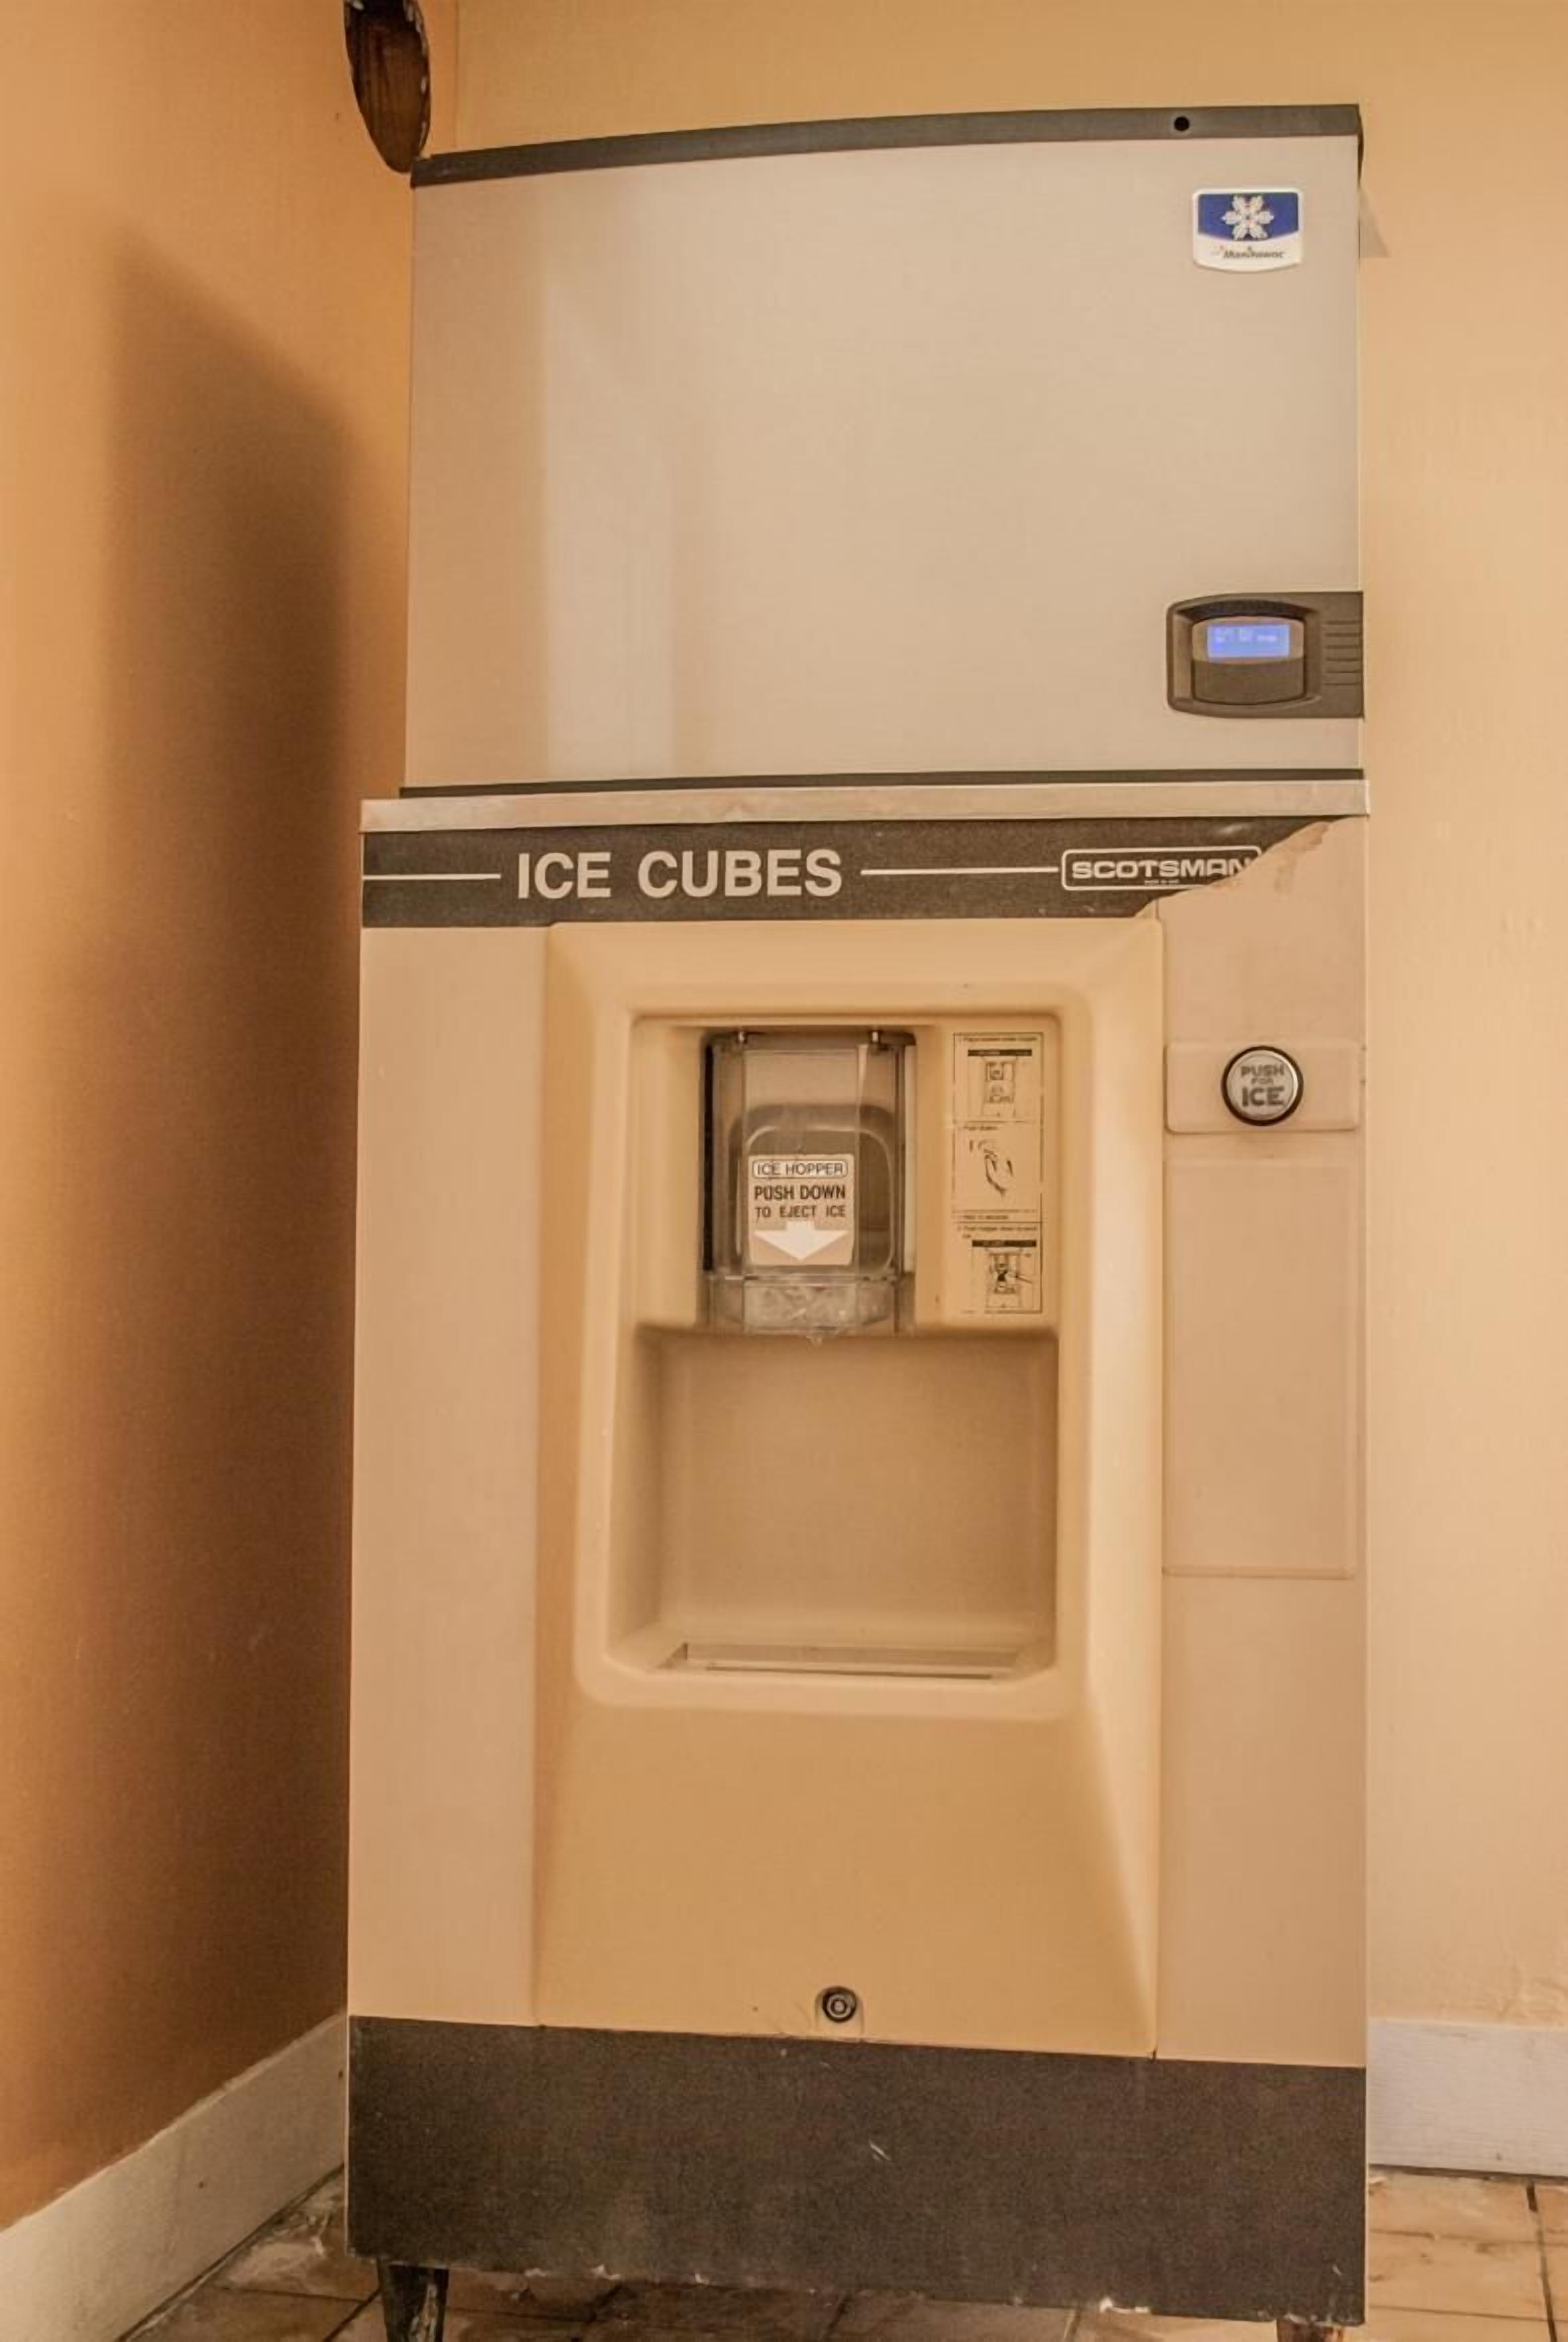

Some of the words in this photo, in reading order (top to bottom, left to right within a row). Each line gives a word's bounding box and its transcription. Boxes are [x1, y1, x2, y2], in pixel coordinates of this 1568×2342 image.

[518, 853, 611, 899] ICE
[638, 849, 842, 898] CUBES
[1241, 1064, 1284, 1077] PUSH
[1242, 1086, 1284, 1107] ICE
[757, 1163, 781, 1175] ICE
[786, 1163, 843, 1175] HOPPER
[754, 1186, 795, 1200] PUSH
[800, 1185, 845, 1200] DOWN
[756, 1207, 771, 1218] TO
[780, 1205, 816, 1217] EJECT
[826, 1205, 846, 1217] ICE
